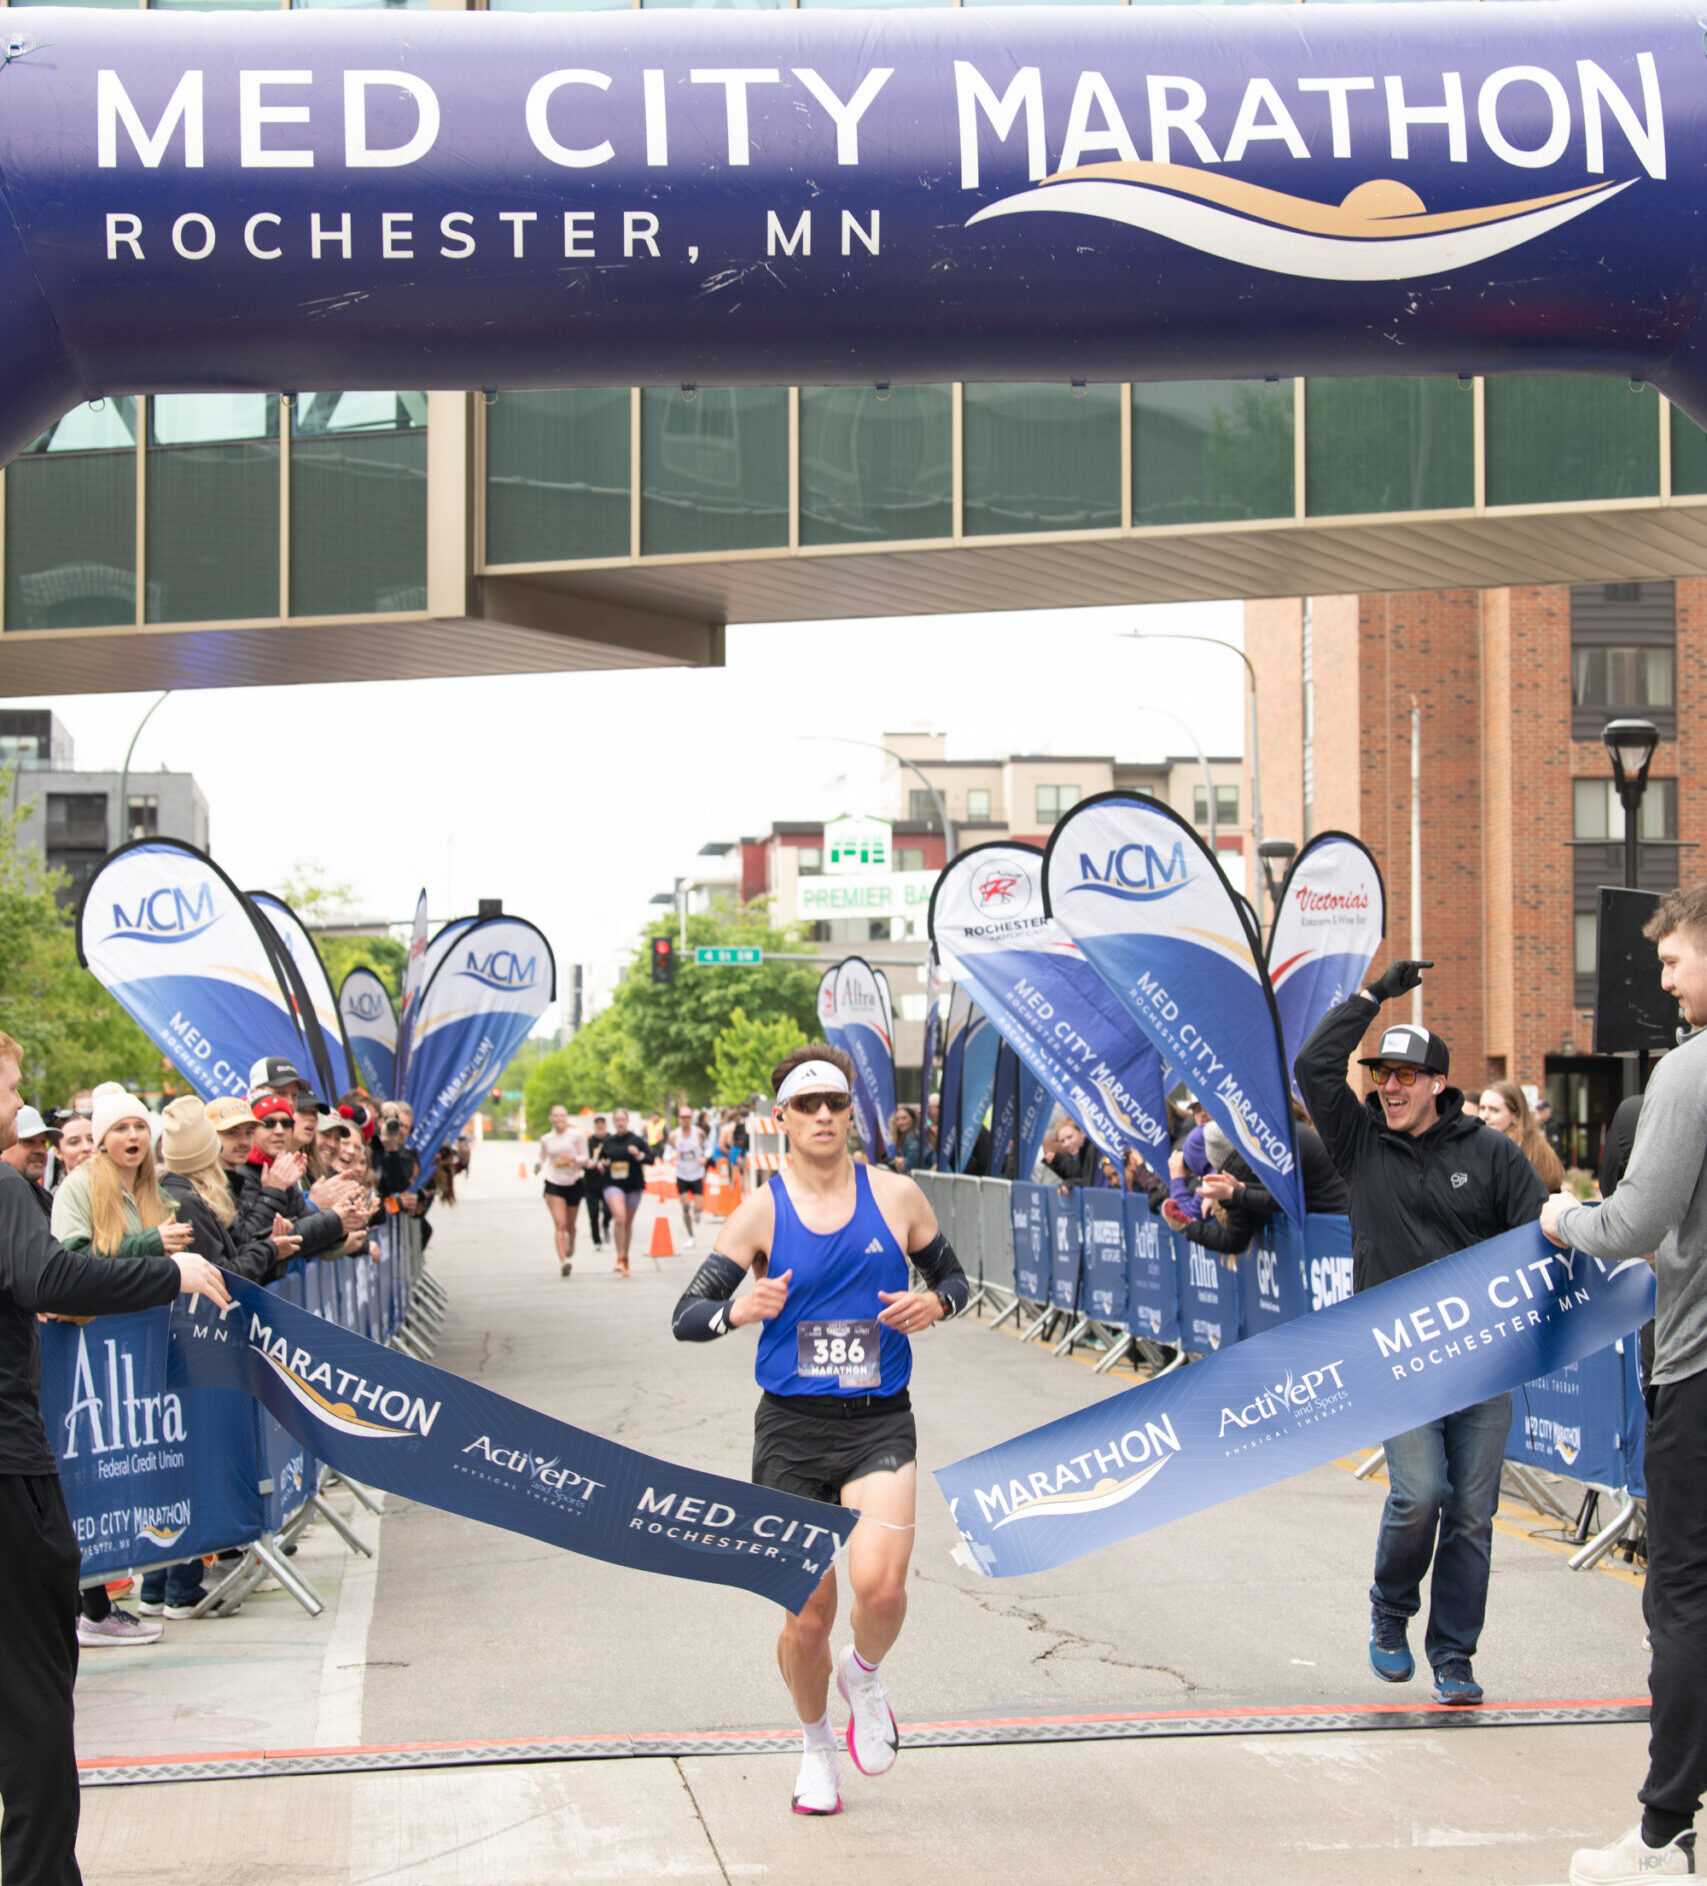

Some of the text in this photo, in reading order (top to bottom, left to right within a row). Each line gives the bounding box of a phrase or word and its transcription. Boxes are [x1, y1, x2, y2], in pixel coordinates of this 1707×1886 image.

[97, 52, 1667, 190] MED CITY MARATHON
[106, 209, 881, 265] ROCHESTER, MN
[803, 884, 931, 910] PREMIER BA
[1296, 884, 1369, 912] Victoria's
[964, 917, 1048, 937] ROCHESTER
[842, 976, 876, 1007] Altra
[169, 1011, 212, 1060] MED
[213, 1060, 248, 1095] CIT
[1014, 978, 1055, 1020] MED
[1055, 1021, 1098, 1064] CITY
[1089, 1061, 1168, 1147] MARATHON
[1066, 1056, 1081, 1073] MN
[1137, 971, 1296, 1176] MED CITY MARATHON
[1192, 1067, 1208, 1087] MN
[1256, 1249, 1280, 1299] GPC
[1310, 1256, 1354, 1312] SCHE
[1371, 1249, 1577, 1359] MED CITY
[193, 1324, 229, 1343] MN
[812, 1338, 866, 1365] 386
[1391, 1287, 1591, 1381] ROCHESTER, MN
[249, 1312, 442, 1438] MARATHON
[811, 1364, 868, 1376] MARATHON
[63, 1326, 188, 1460] Altra
[1293, 1389, 1349, 1419] and Sports
[1225, 1401, 1352, 1458] PHYSICAL THERAPY
[1539, 1418, 1553, 1441] CITY
[98, 1450, 184, 1480] Federal Credit Union
[973, 1412, 1182, 1524] MARATHON
[530, 1481, 585, 1509] and Sports
[637, 1486, 737, 1528] MED
[100, 1509, 130, 1537] CITY
[133, 1498, 191, 1535] MARATHON
[802, 1558, 820, 1575] M
